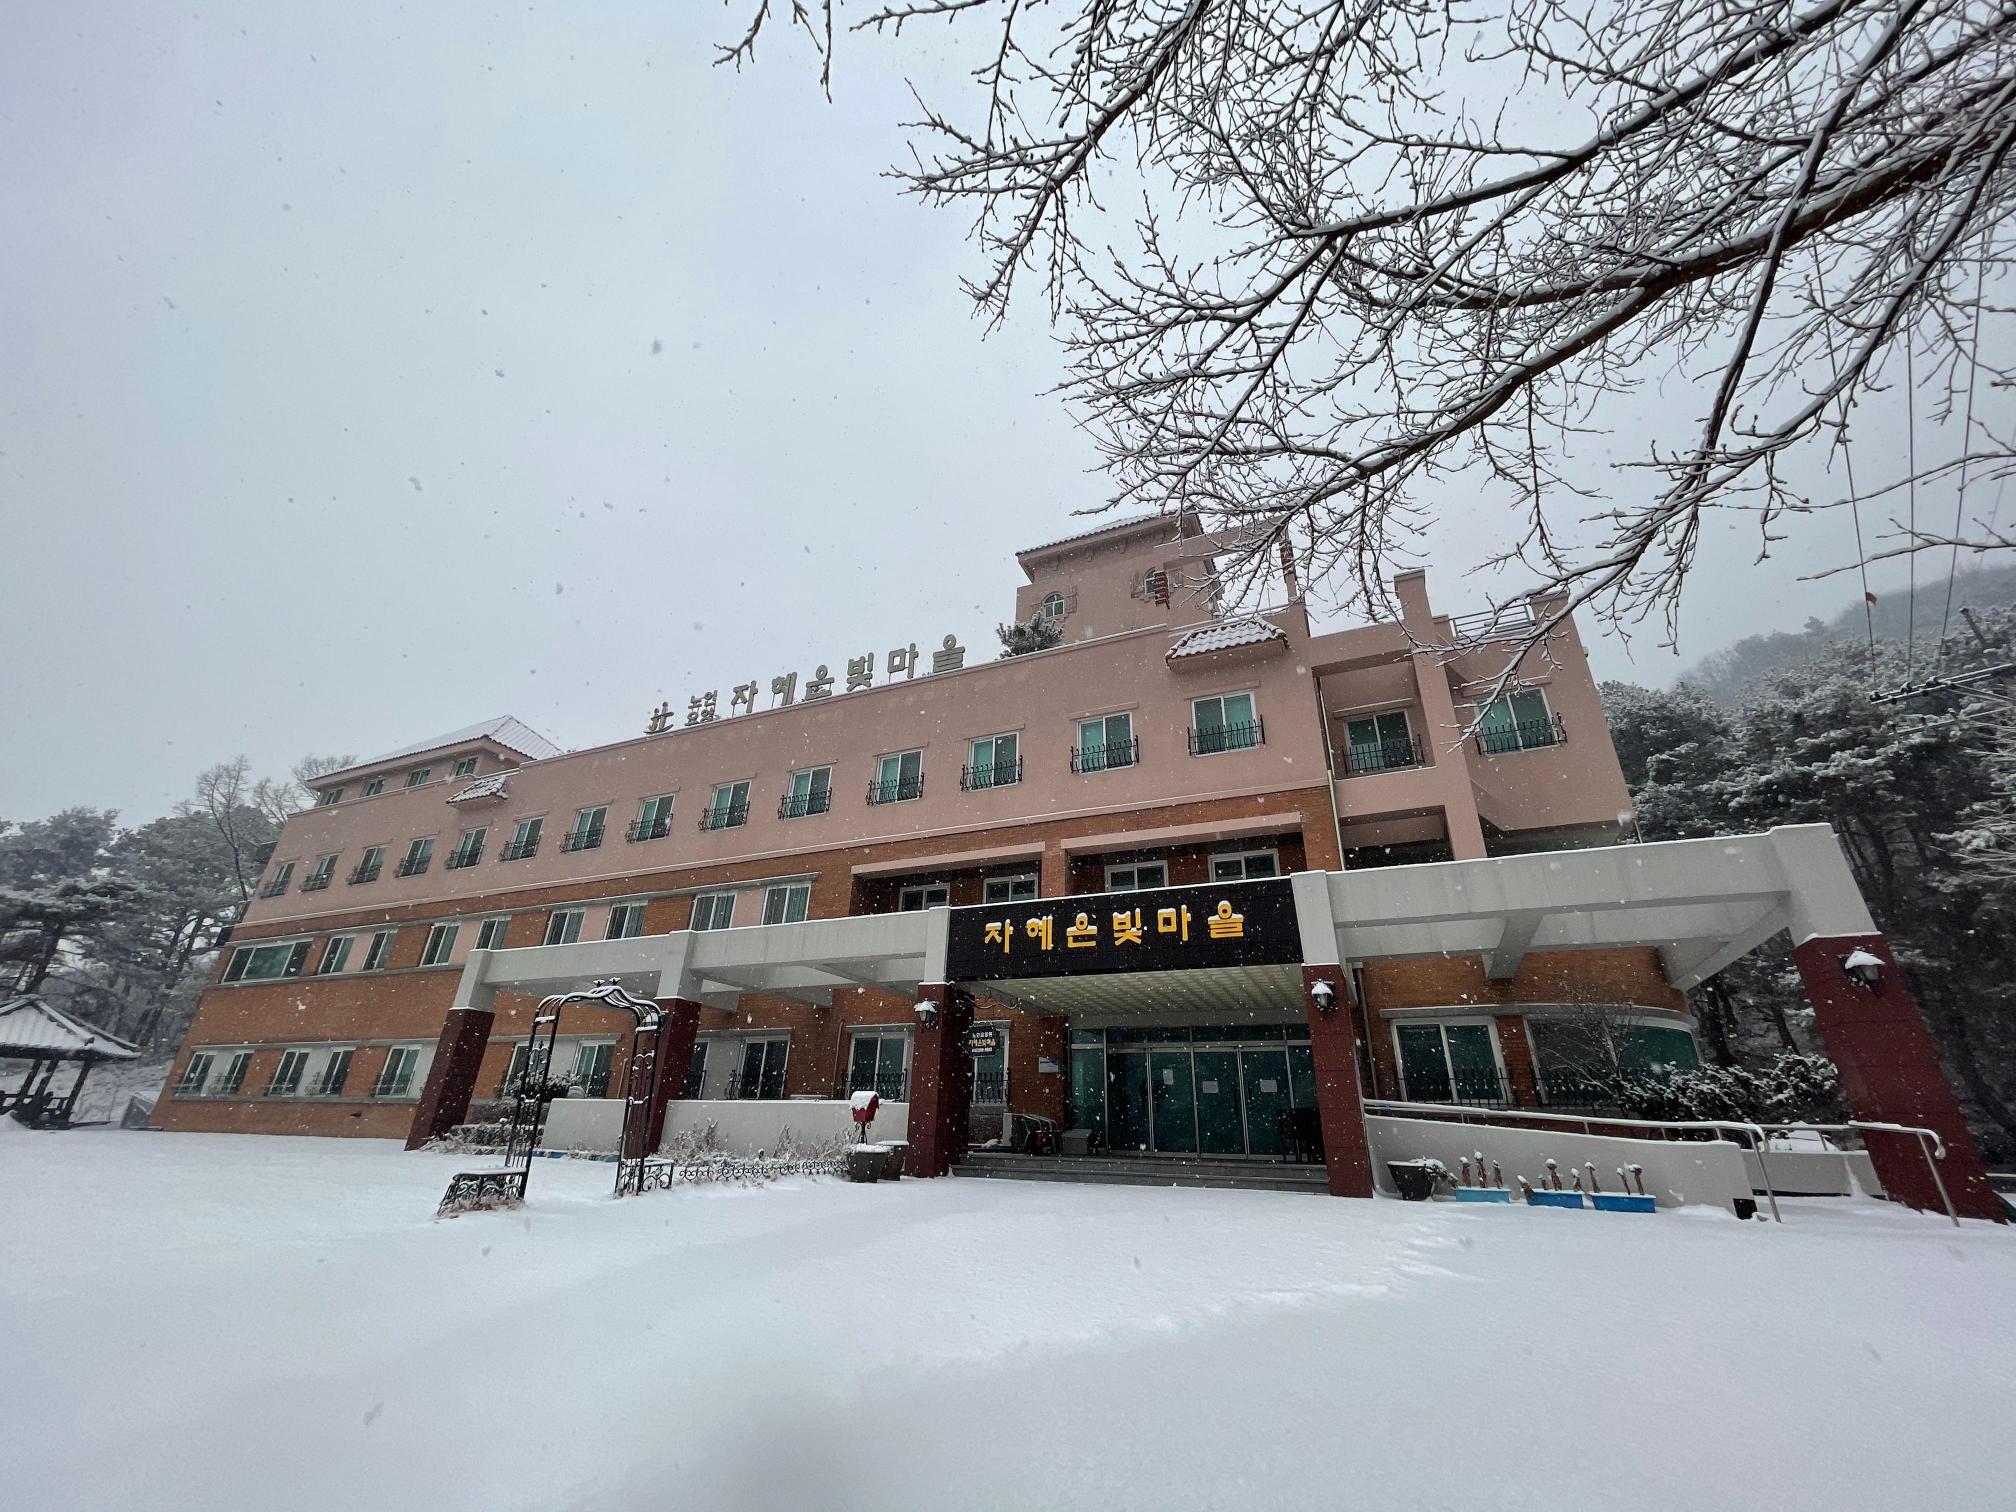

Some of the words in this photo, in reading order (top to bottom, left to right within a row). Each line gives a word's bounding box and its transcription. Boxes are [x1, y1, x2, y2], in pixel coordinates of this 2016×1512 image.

[688, 689, 718, 709] 노인
[731, 633, 966, 714] 자예은빛마을
[984, 900, 1244, 954] 자예은빛마을
